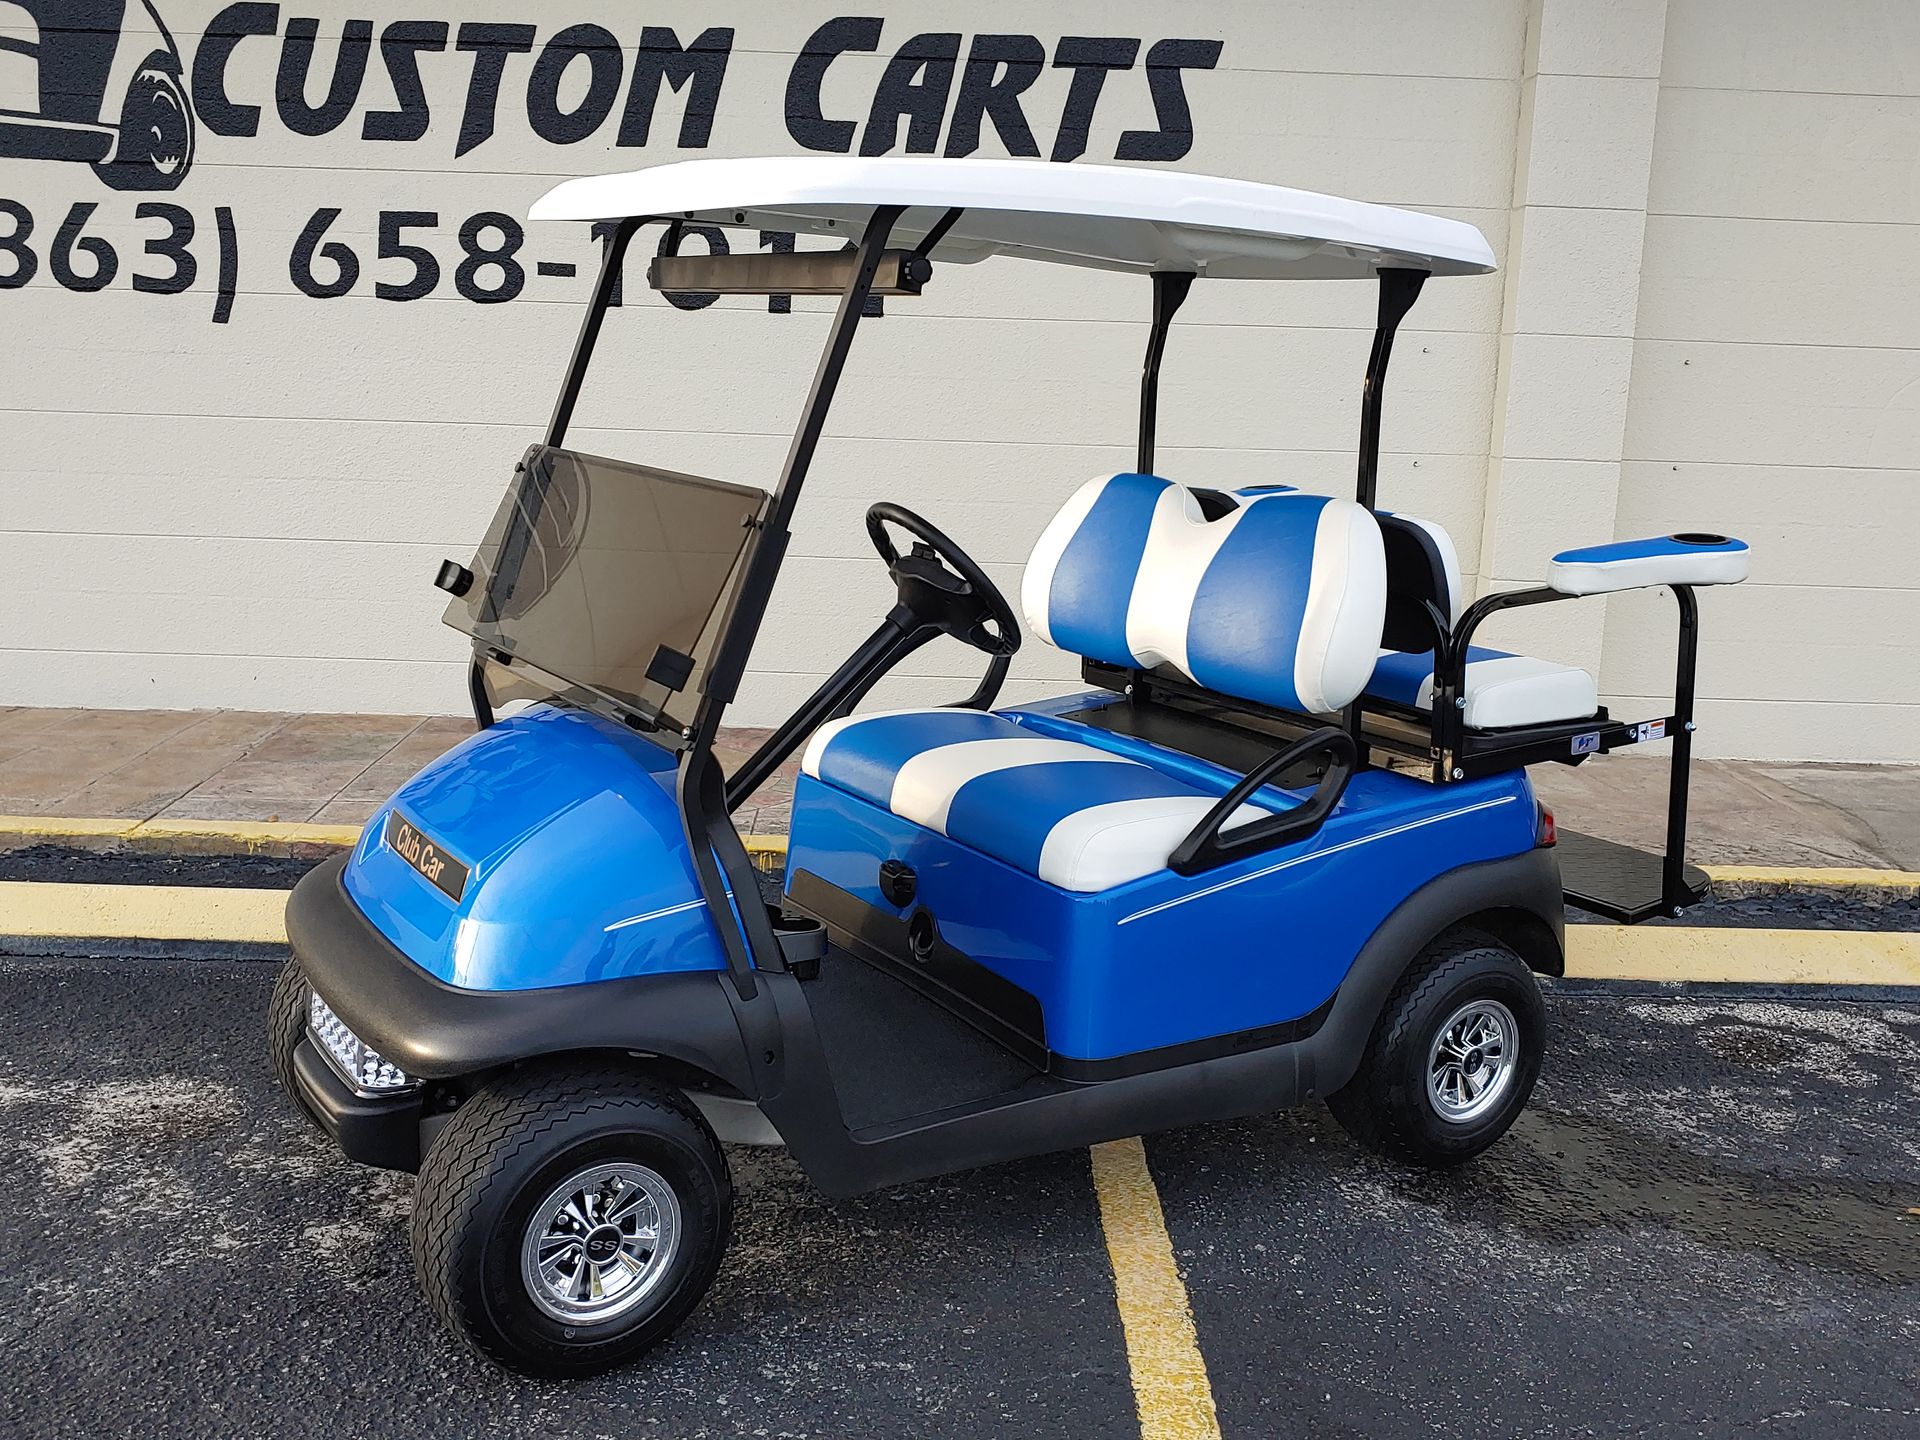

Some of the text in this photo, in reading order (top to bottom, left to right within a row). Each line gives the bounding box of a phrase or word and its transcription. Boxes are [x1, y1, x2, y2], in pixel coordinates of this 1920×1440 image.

[192, 2, 1224, 162] CUSTOM CARTS
[396, 823, 445, 881] Club Car
[590, 1240, 618, 1250] SS
